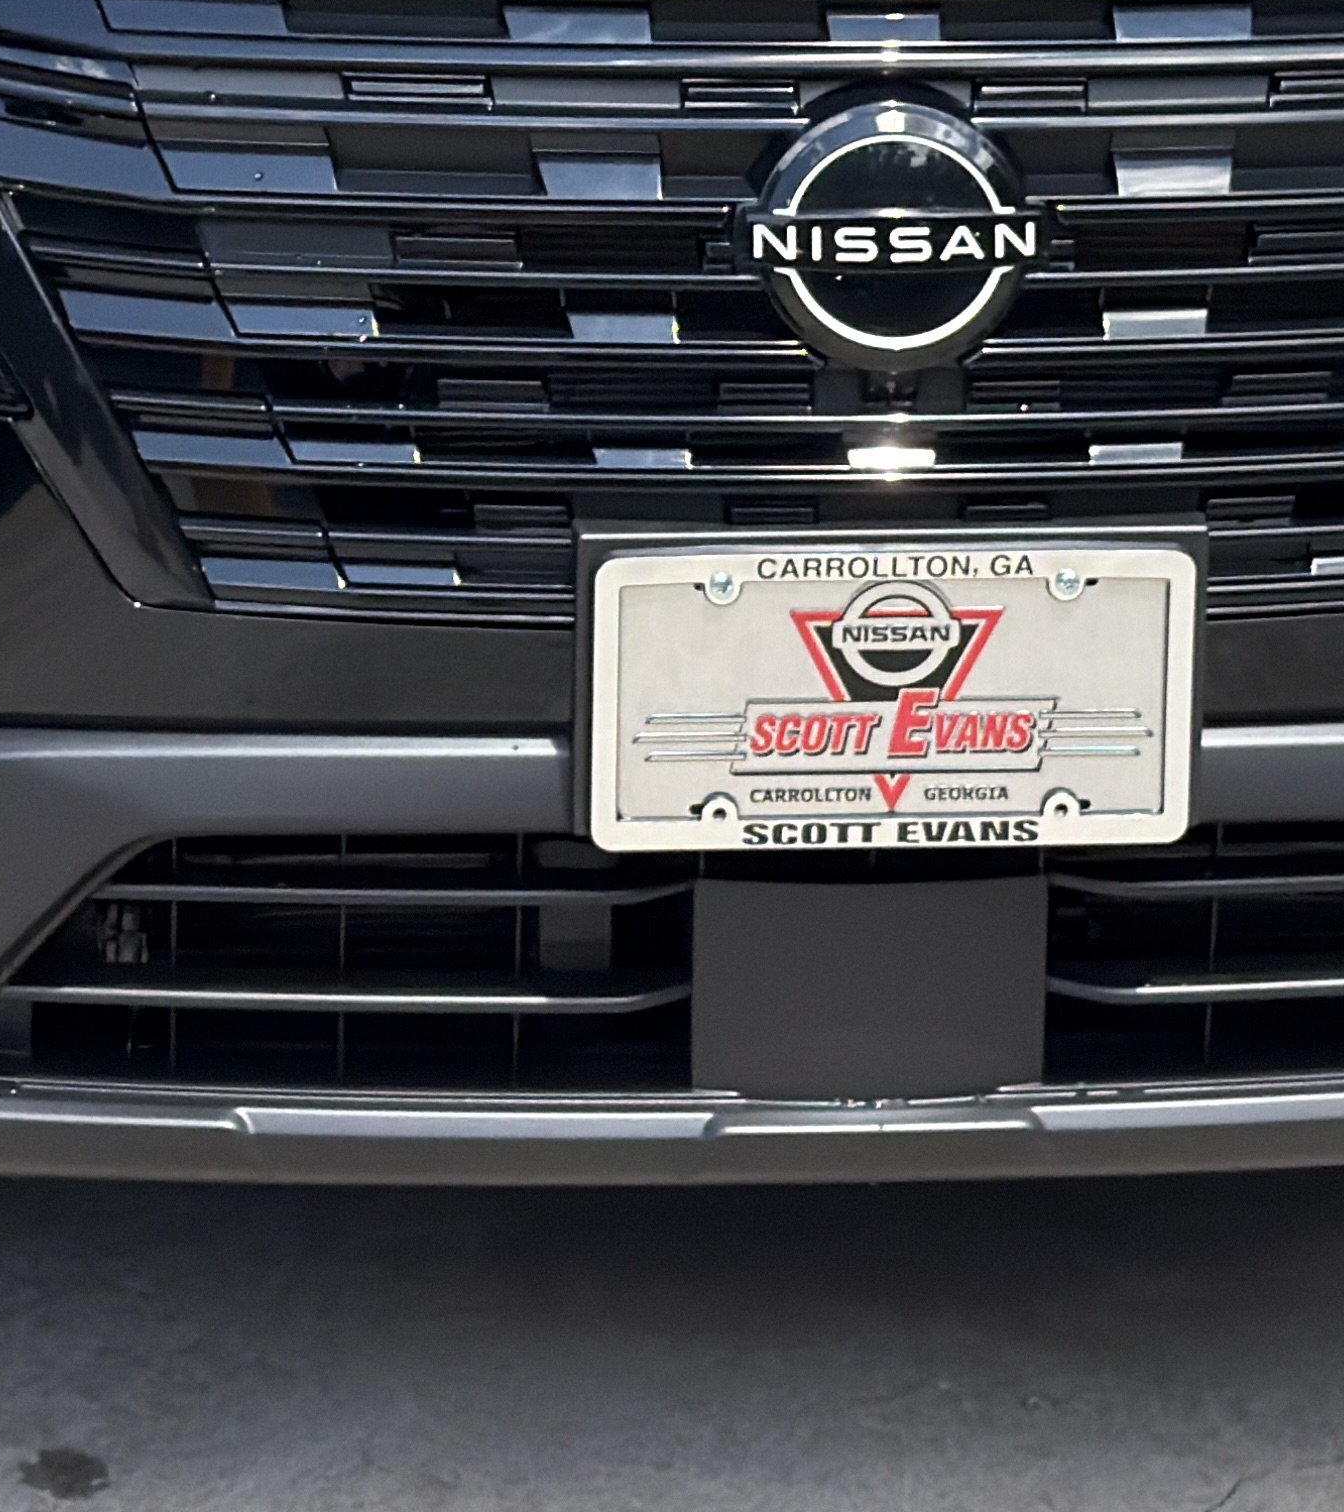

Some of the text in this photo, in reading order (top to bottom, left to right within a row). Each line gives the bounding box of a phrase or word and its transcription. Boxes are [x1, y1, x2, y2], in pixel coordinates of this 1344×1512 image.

[752, 221, 1036, 264] NISSAN
[757, 554, 1033, 580] CARROLLTON, GA
[842, 624, 950, 643] NISSAN
[750, 687, 1036, 758] SCOTT EVANS
[749, 787, 872, 804] CARROLLTON
[923, 785, 1009, 802] GEORGIA
[742, 819, 1039, 845] SCOTT EVANS
